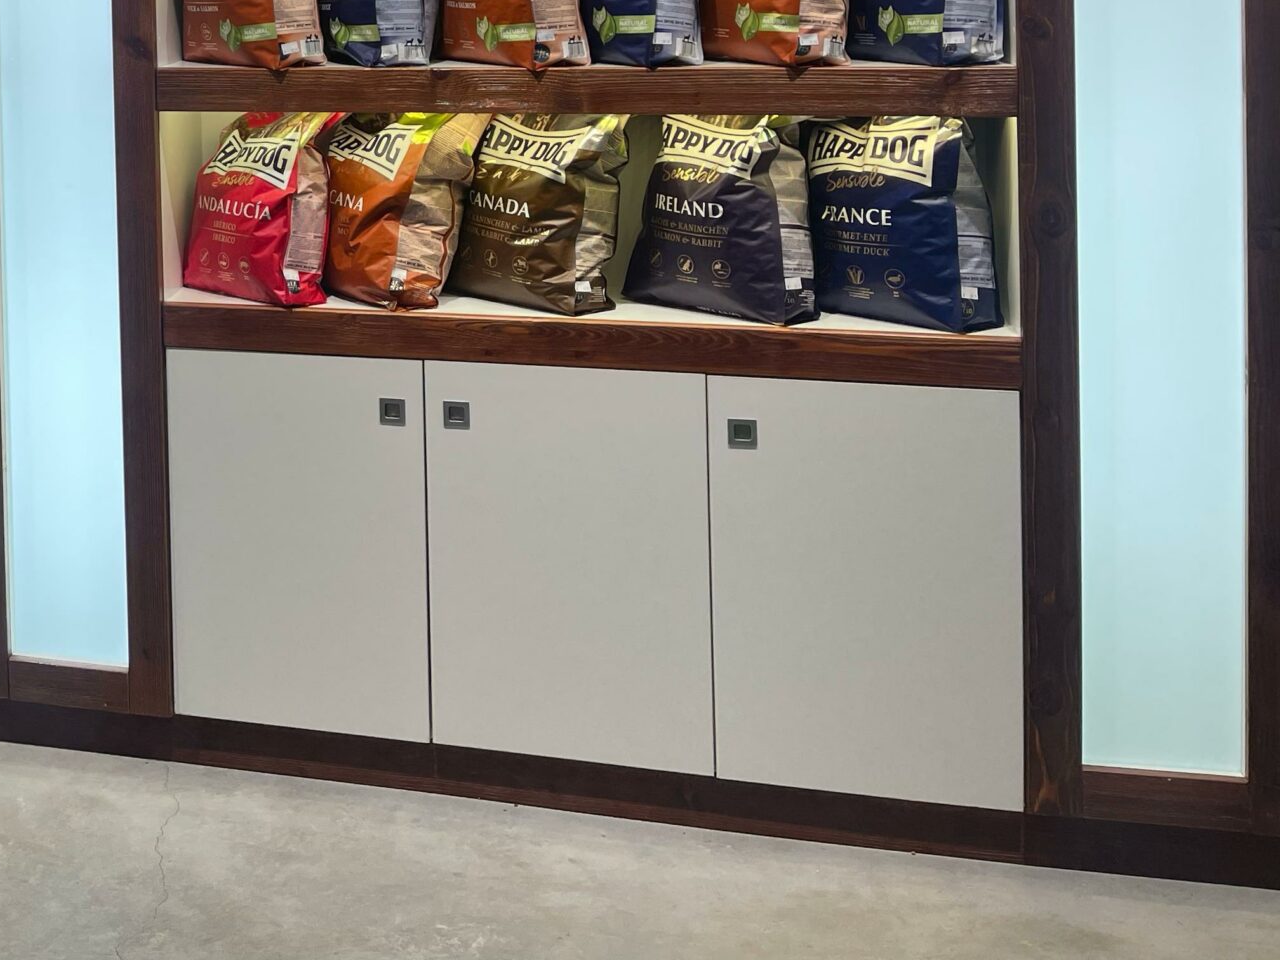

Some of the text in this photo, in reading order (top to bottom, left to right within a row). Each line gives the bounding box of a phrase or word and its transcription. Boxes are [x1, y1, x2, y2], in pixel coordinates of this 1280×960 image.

[254, 144, 292, 175] DOG
[362, 134, 407, 166] DOG
[872, 134, 928, 168] DOG
[661, 164, 721, 184] Sensible
[198, 194, 272, 221] ANDALUCÍA
[329, 190, 364, 212] CANA
[655, 193, 724, 219] IRELAND
[821, 205, 892, 227] FRANCE
[864, 247, 890, 256] DUCK
